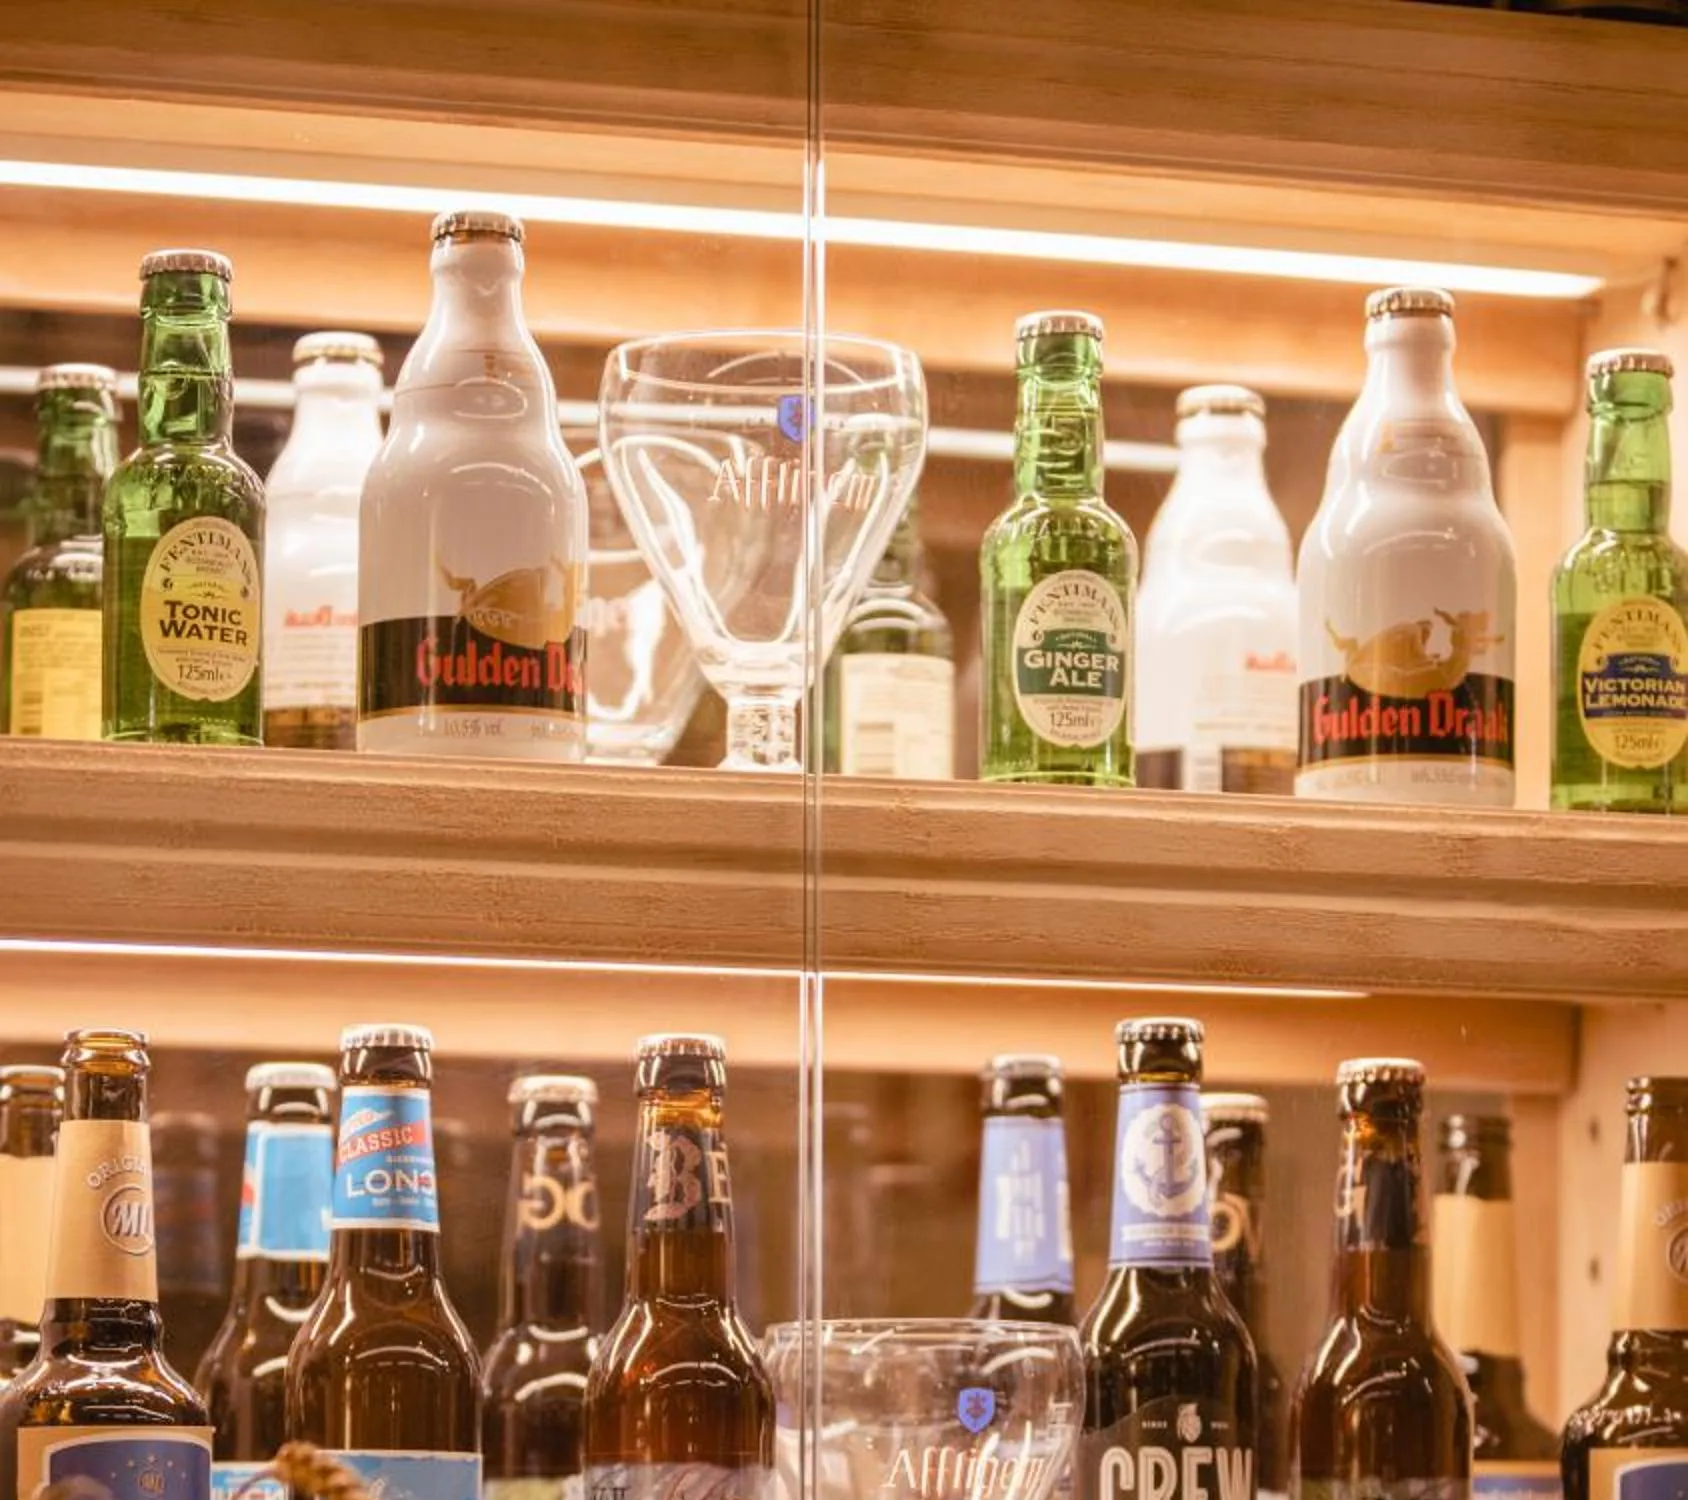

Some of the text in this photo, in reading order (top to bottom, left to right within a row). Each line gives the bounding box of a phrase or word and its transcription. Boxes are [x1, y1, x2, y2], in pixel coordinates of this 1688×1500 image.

[163, 600, 243, 625] TONIC
[159, 619, 248, 647] WATER
[415, 634, 541, 688] Gulden
[1024, 650, 1119, 672] GINGER
[1050, 668, 1103, 687] ALE
[1584, 677, 1686, 694] VICTORIAN
[1313, 695, 1421, 744] Gulden
